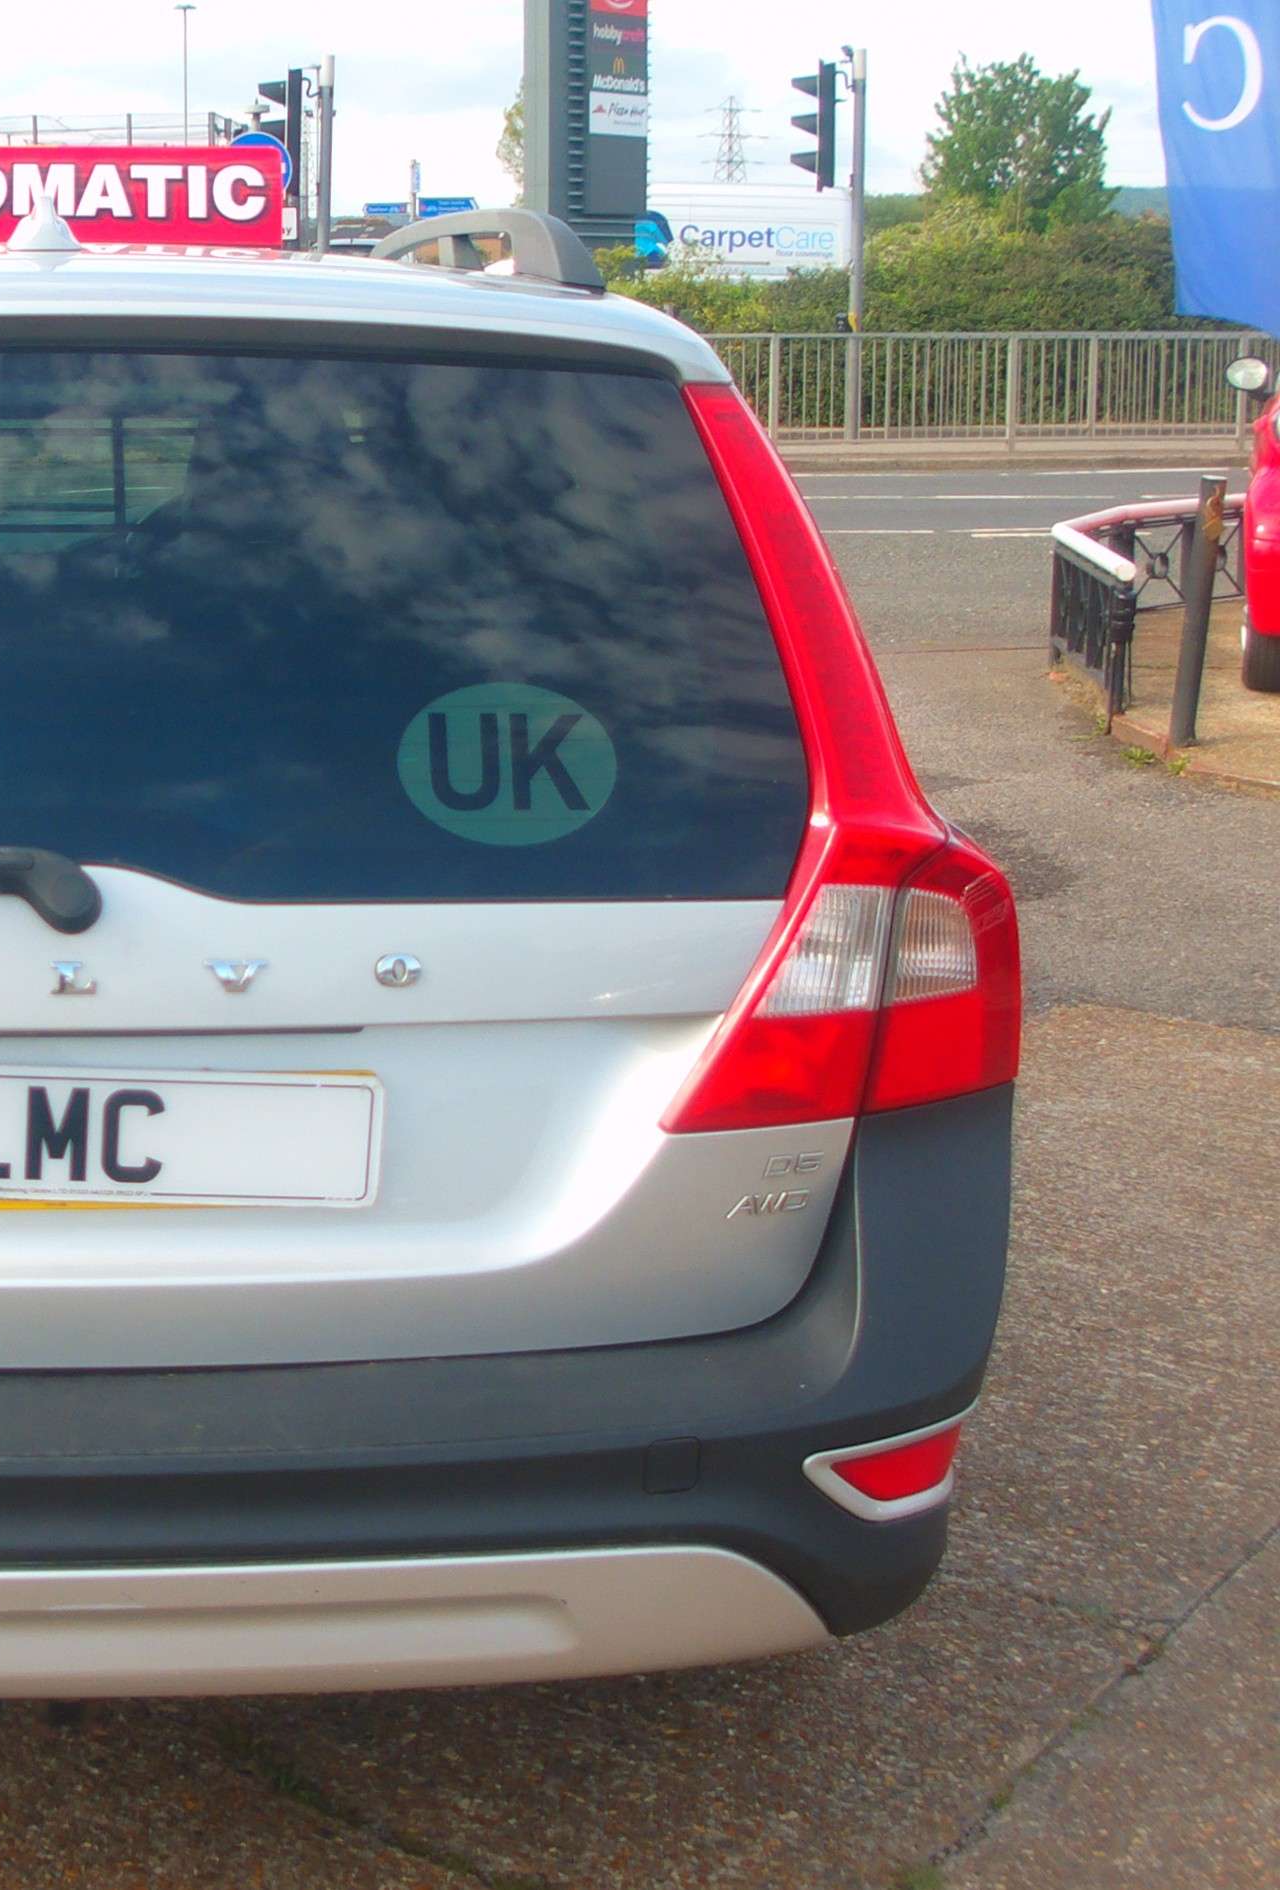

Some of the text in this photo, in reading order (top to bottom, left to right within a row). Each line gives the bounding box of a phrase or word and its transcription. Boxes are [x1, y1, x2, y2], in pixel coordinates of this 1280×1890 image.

[593, 73, 645, 92] McDonald's
[680, 225, 835, 252] CarpetCare
[428, 712, 591, 811] UK
[726, 1189, 810, 1219] AWD
